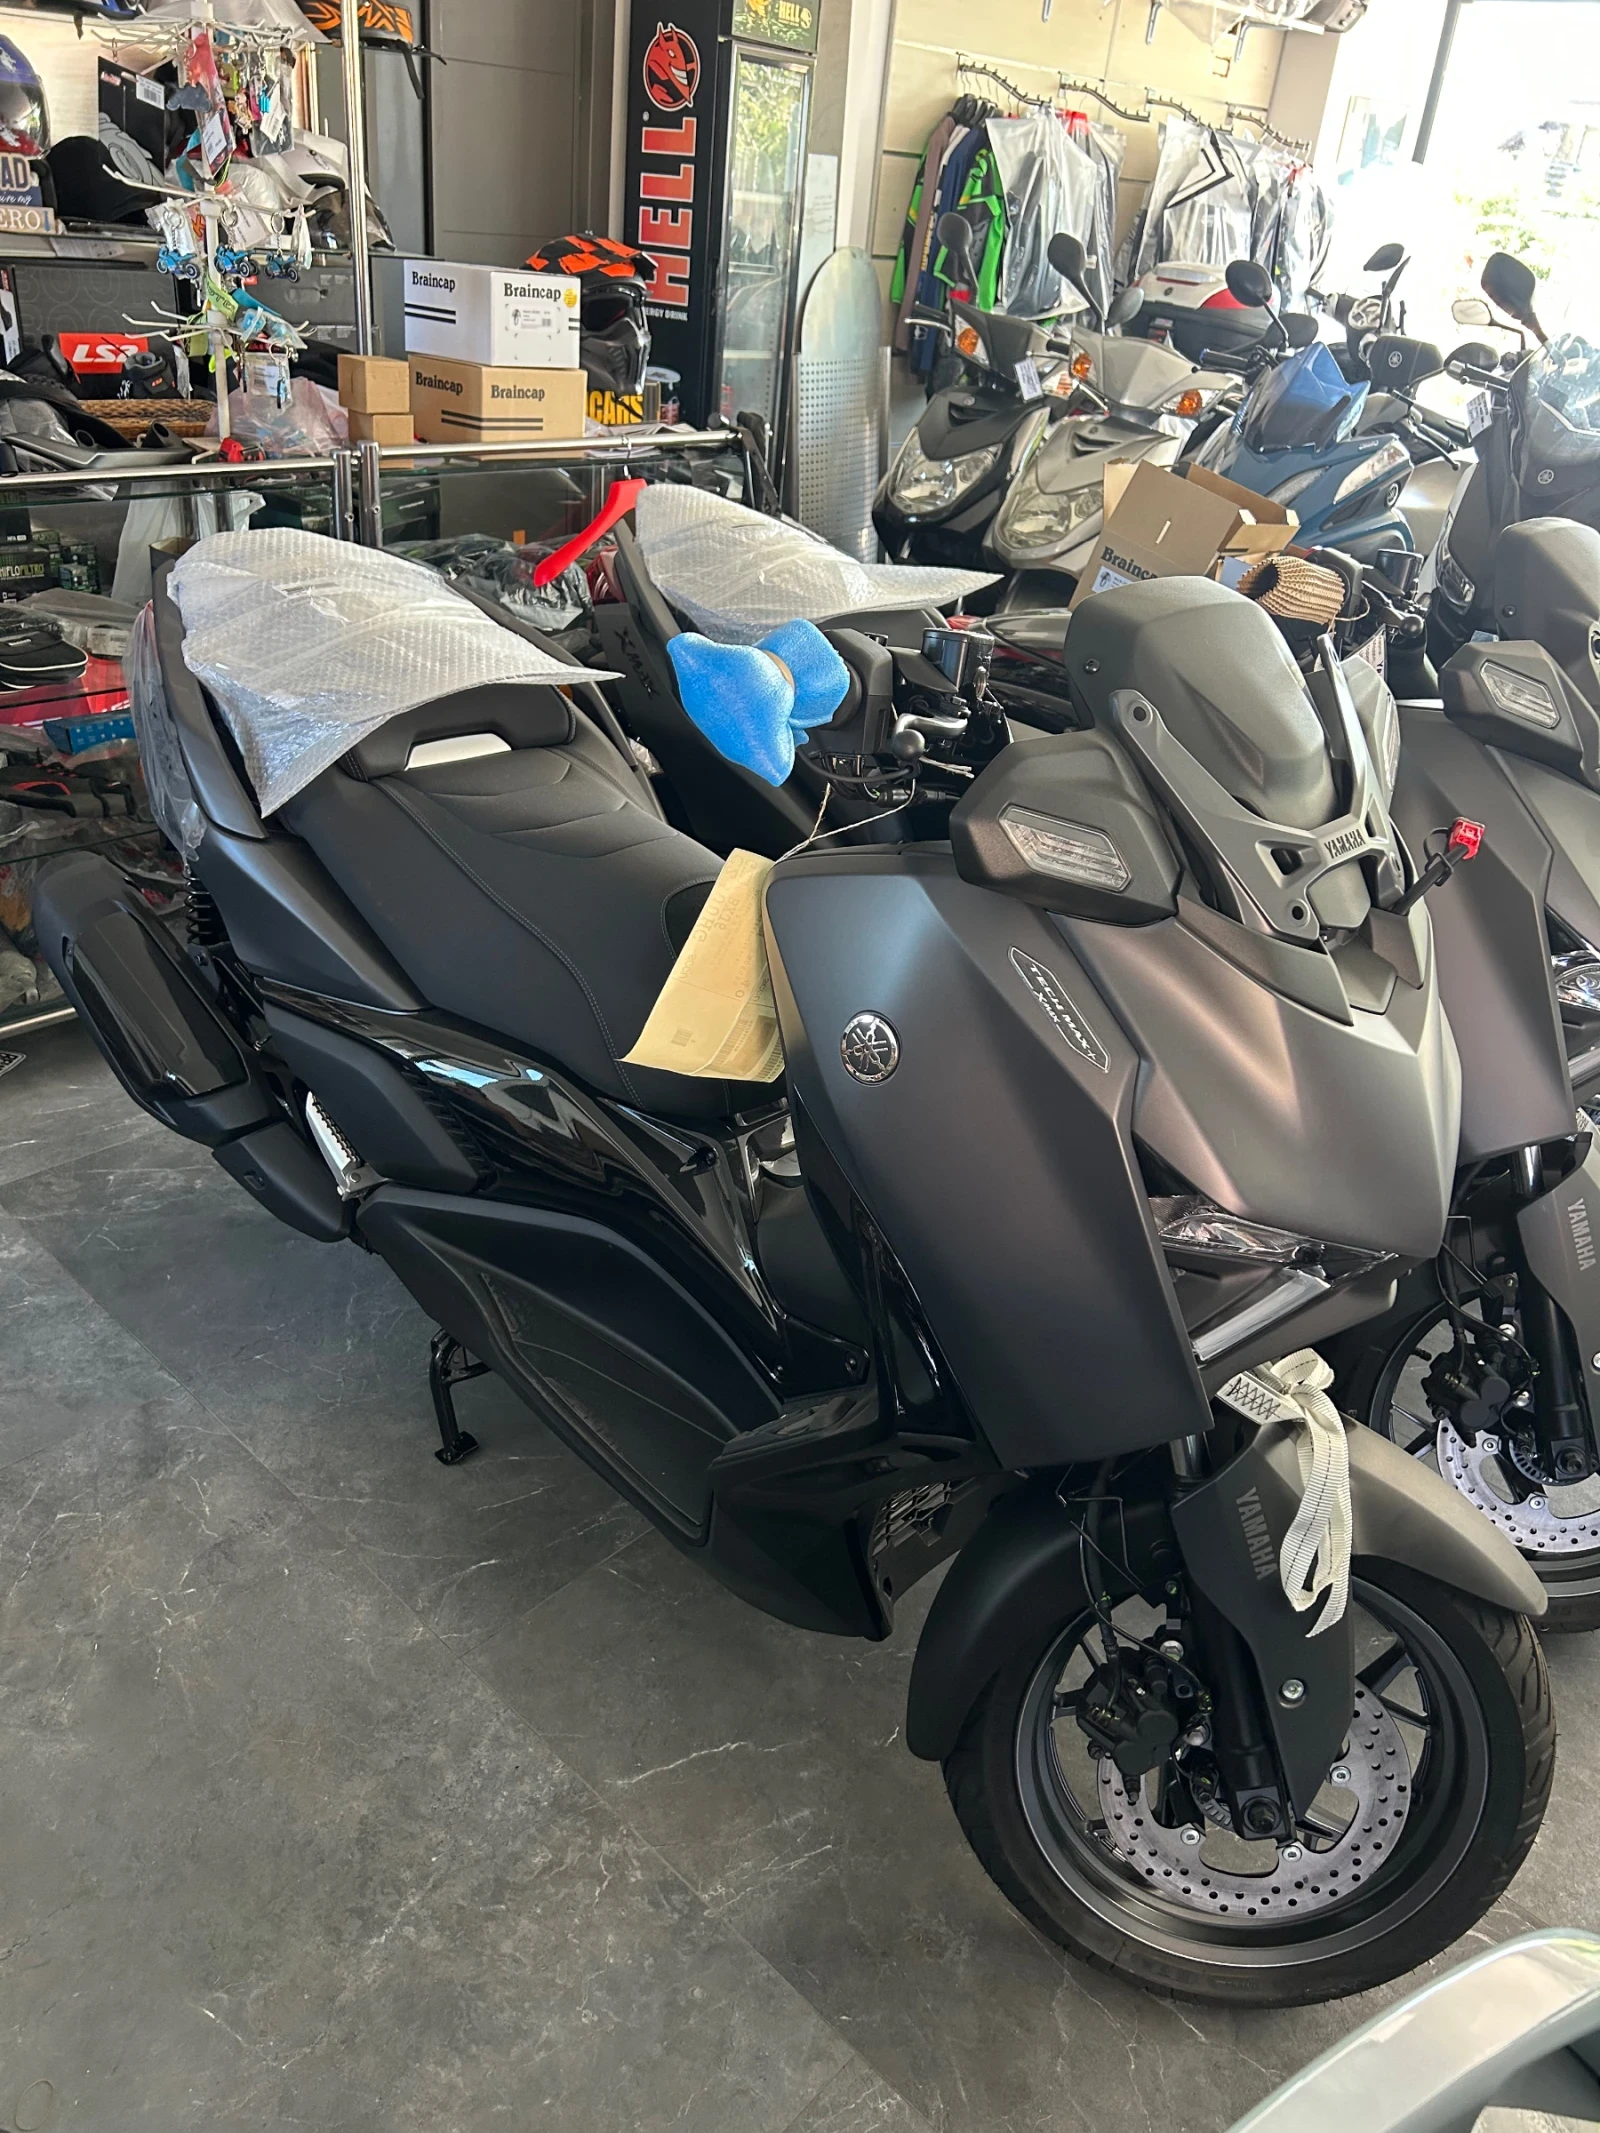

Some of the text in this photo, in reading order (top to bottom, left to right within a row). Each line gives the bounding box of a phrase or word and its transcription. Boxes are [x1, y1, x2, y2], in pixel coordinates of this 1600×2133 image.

[638, 116, 697, 307] HELL
[412, 271, 456, 293] Braincap
[504, 282, 562, 303] Braincap
[664, 309, 688, 321] DRINK
[415, 371, 463, 396] Braincap
[491, 384, 545, 402] Braincap
[1323, 828, 1367, 860] YAMAHA
[1030, 963, 1065, 1011] TECH
[1567, 1197, 1597, 1269] YAMAHA
[1235, 1485, 1279, 1581] YAMAHA
